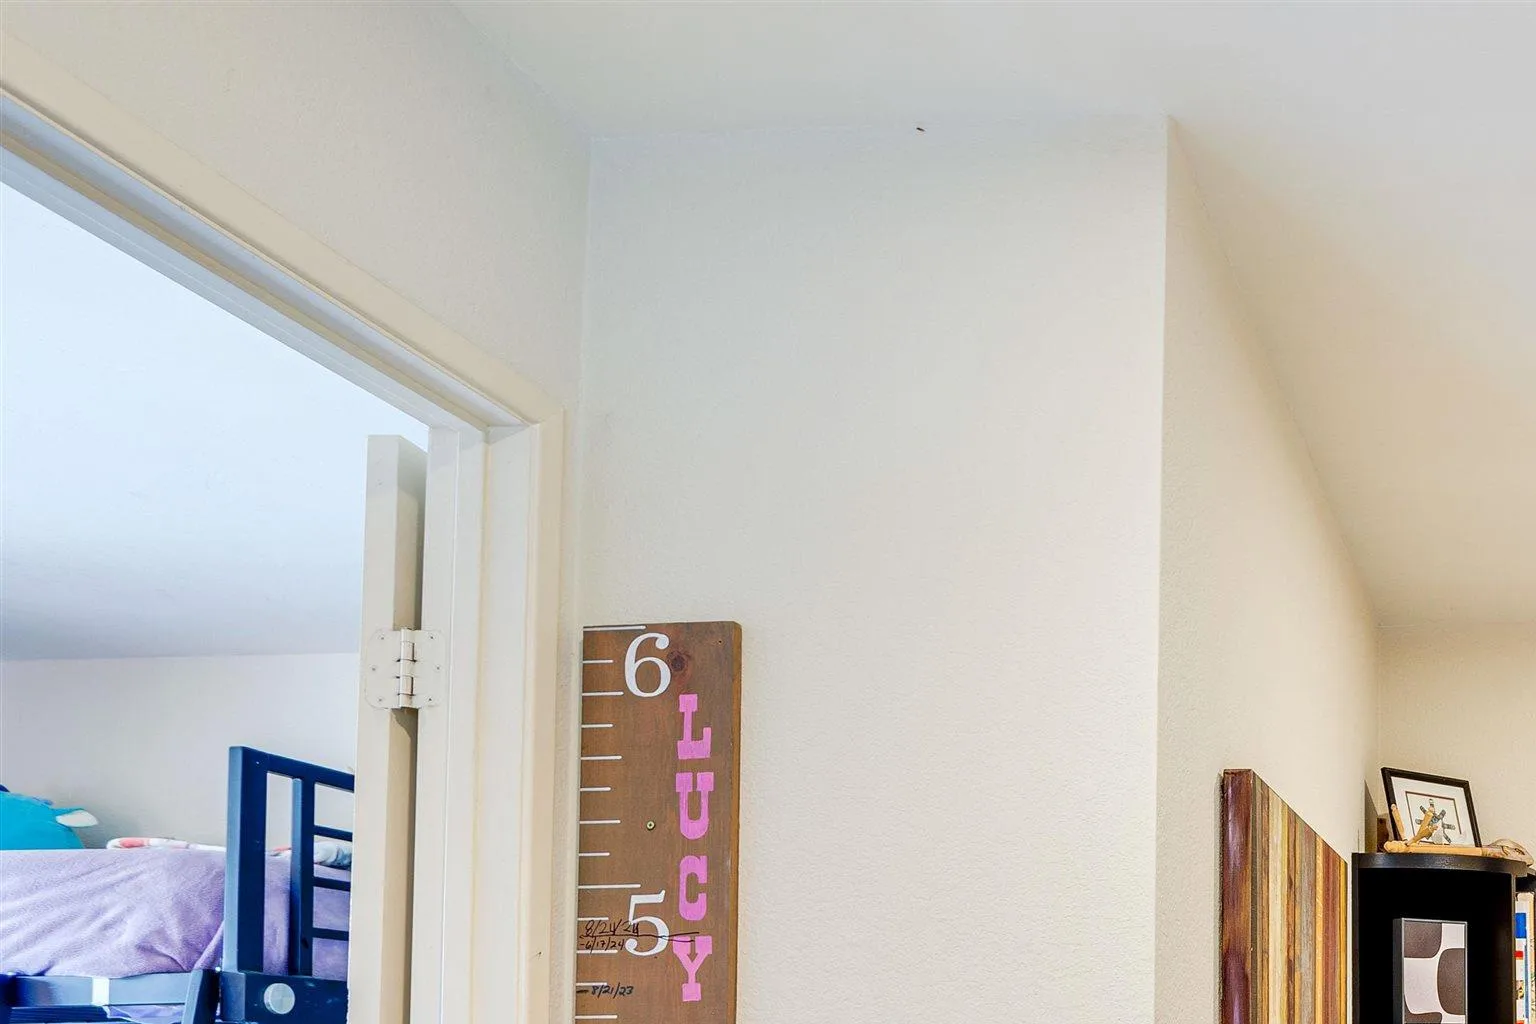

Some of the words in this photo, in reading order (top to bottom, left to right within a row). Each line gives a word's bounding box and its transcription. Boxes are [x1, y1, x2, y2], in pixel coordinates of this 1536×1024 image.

[624, 632, 671, 697] 6
[672, 693, 714, 1001] LUCY
[625, 889, 670, 956] 5
